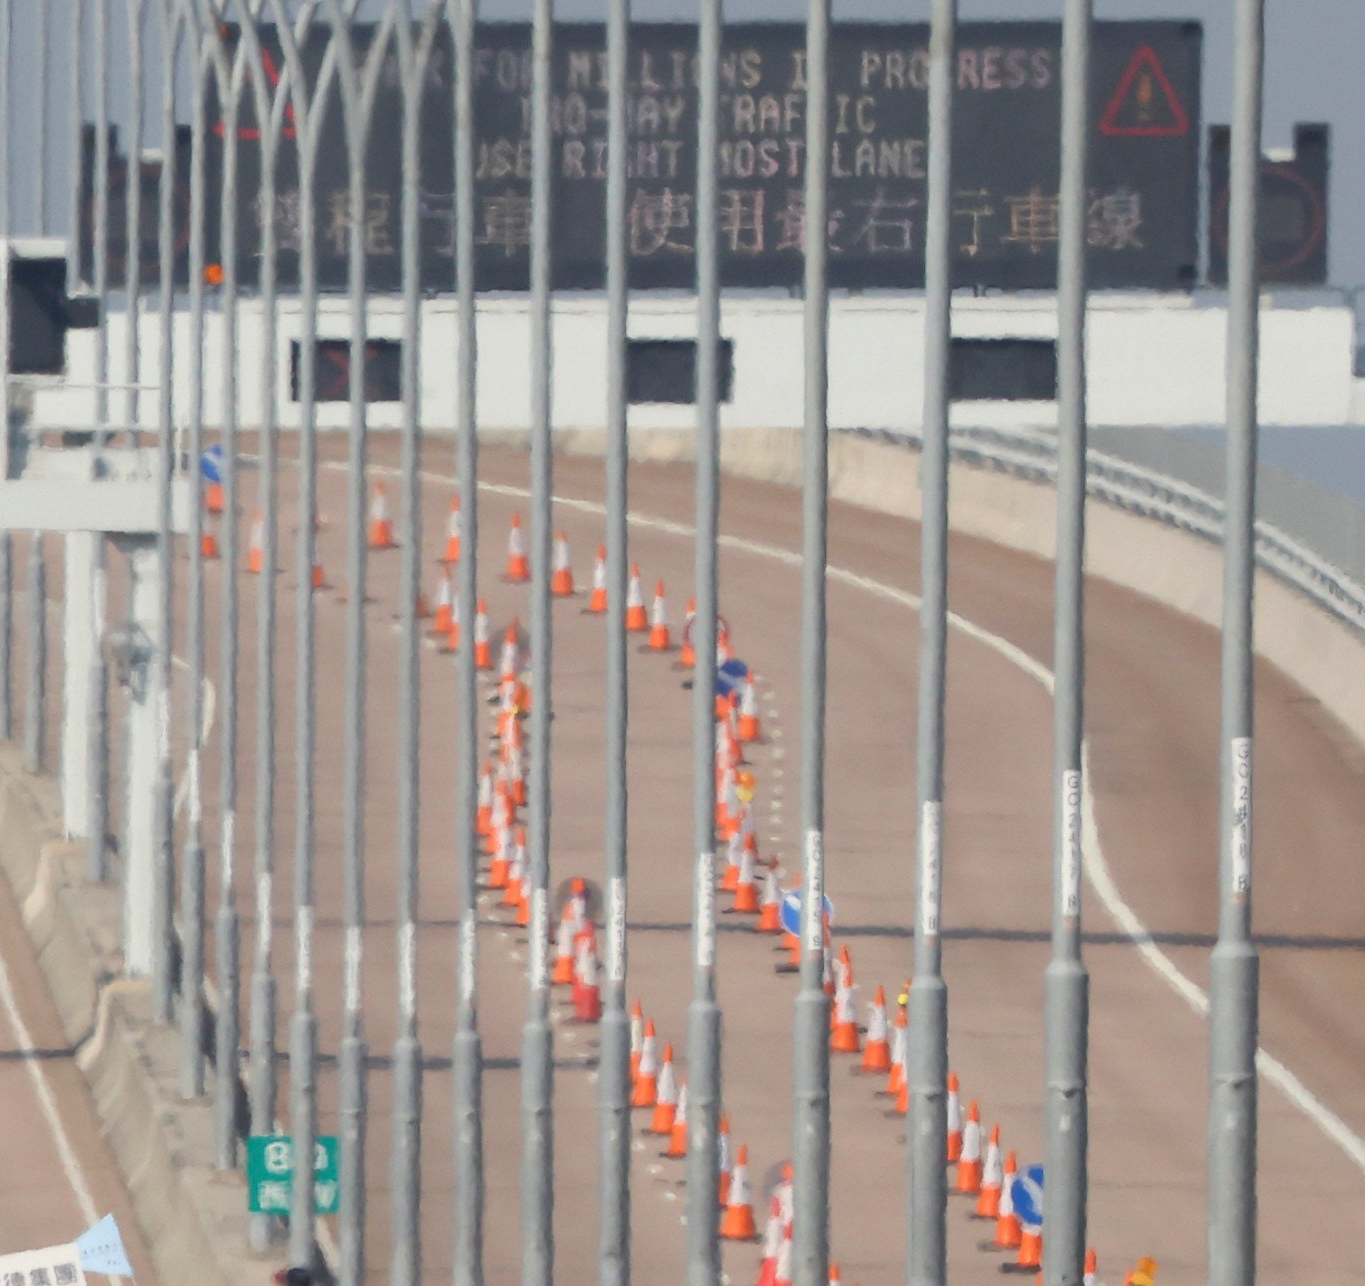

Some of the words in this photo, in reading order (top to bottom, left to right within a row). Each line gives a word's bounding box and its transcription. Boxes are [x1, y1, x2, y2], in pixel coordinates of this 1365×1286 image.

[860, 49, 1052, 90] PRORESS
[563, 139, 685, 180] RIHT
[831, 139, 926, 179] LANE
